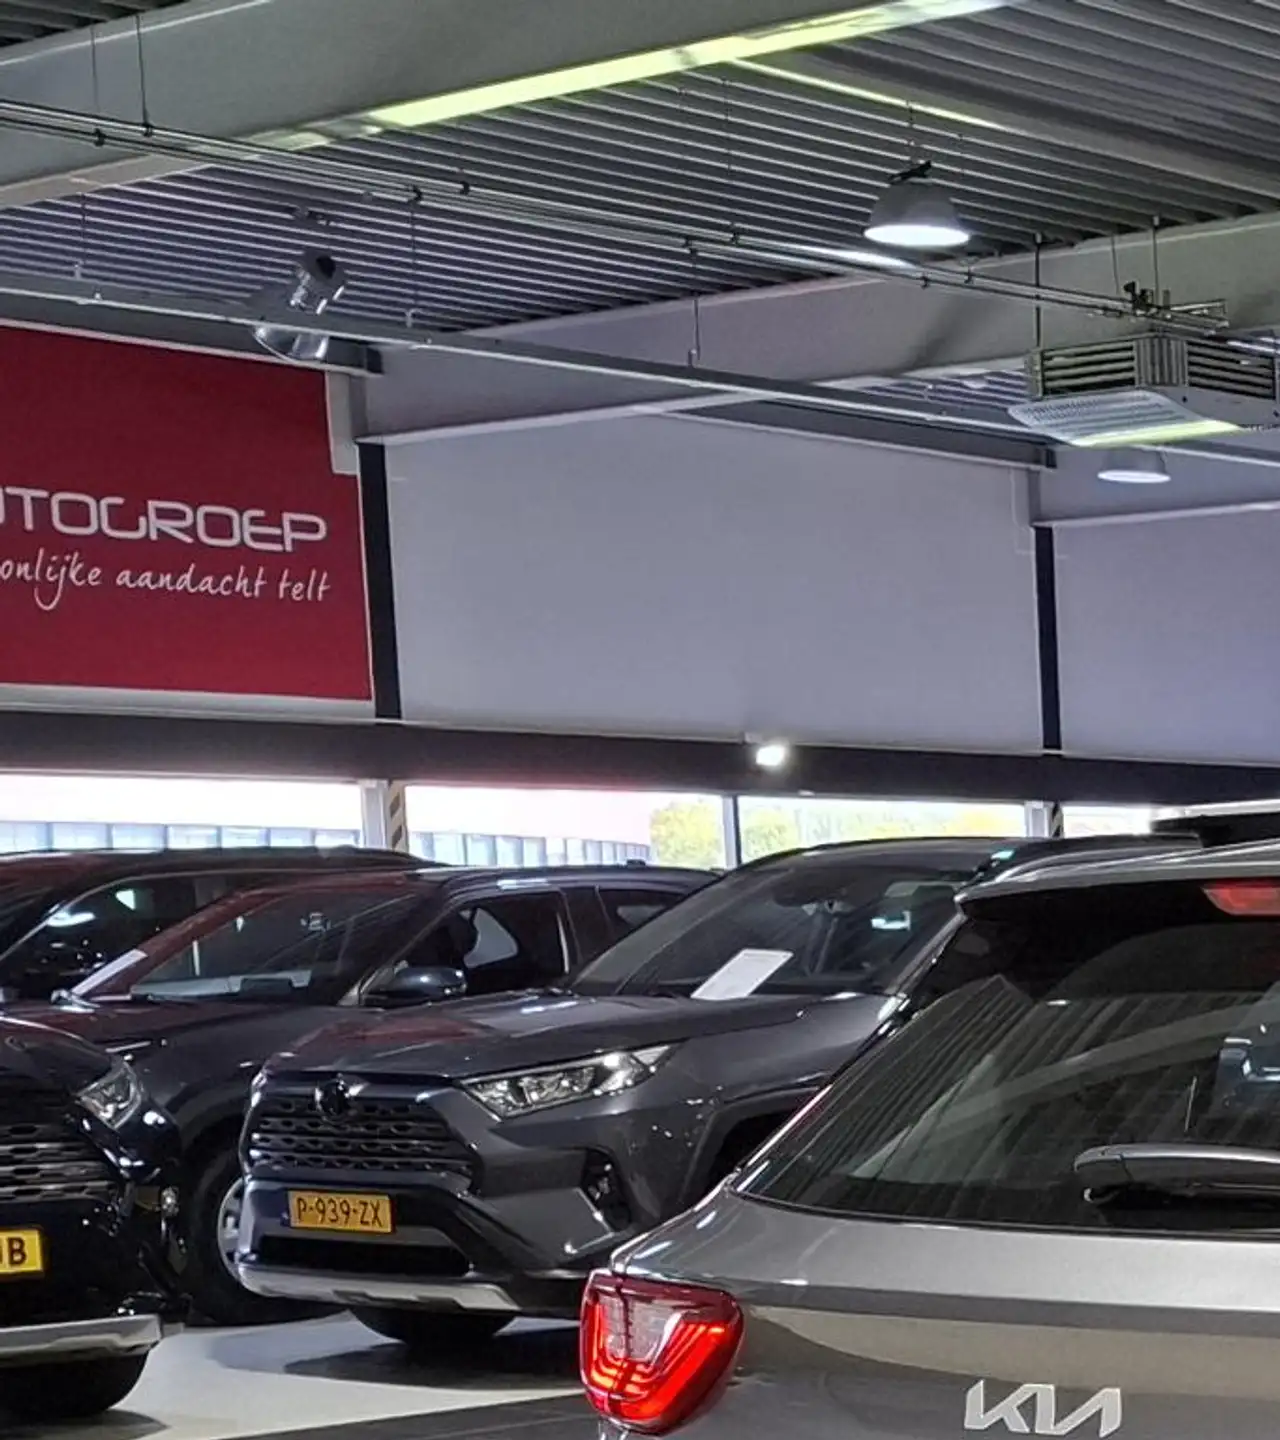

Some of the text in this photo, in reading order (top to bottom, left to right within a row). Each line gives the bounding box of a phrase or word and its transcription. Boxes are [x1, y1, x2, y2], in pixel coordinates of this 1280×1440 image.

[0, 486, 327, 552] TOGROEP
[116, 563, 267, 598] aandacht
[278, 567, 330, 601] telt
[296, 1197, 384, 1229] P-939-ZX
[964, 1379, 1122, 1438] KIA
